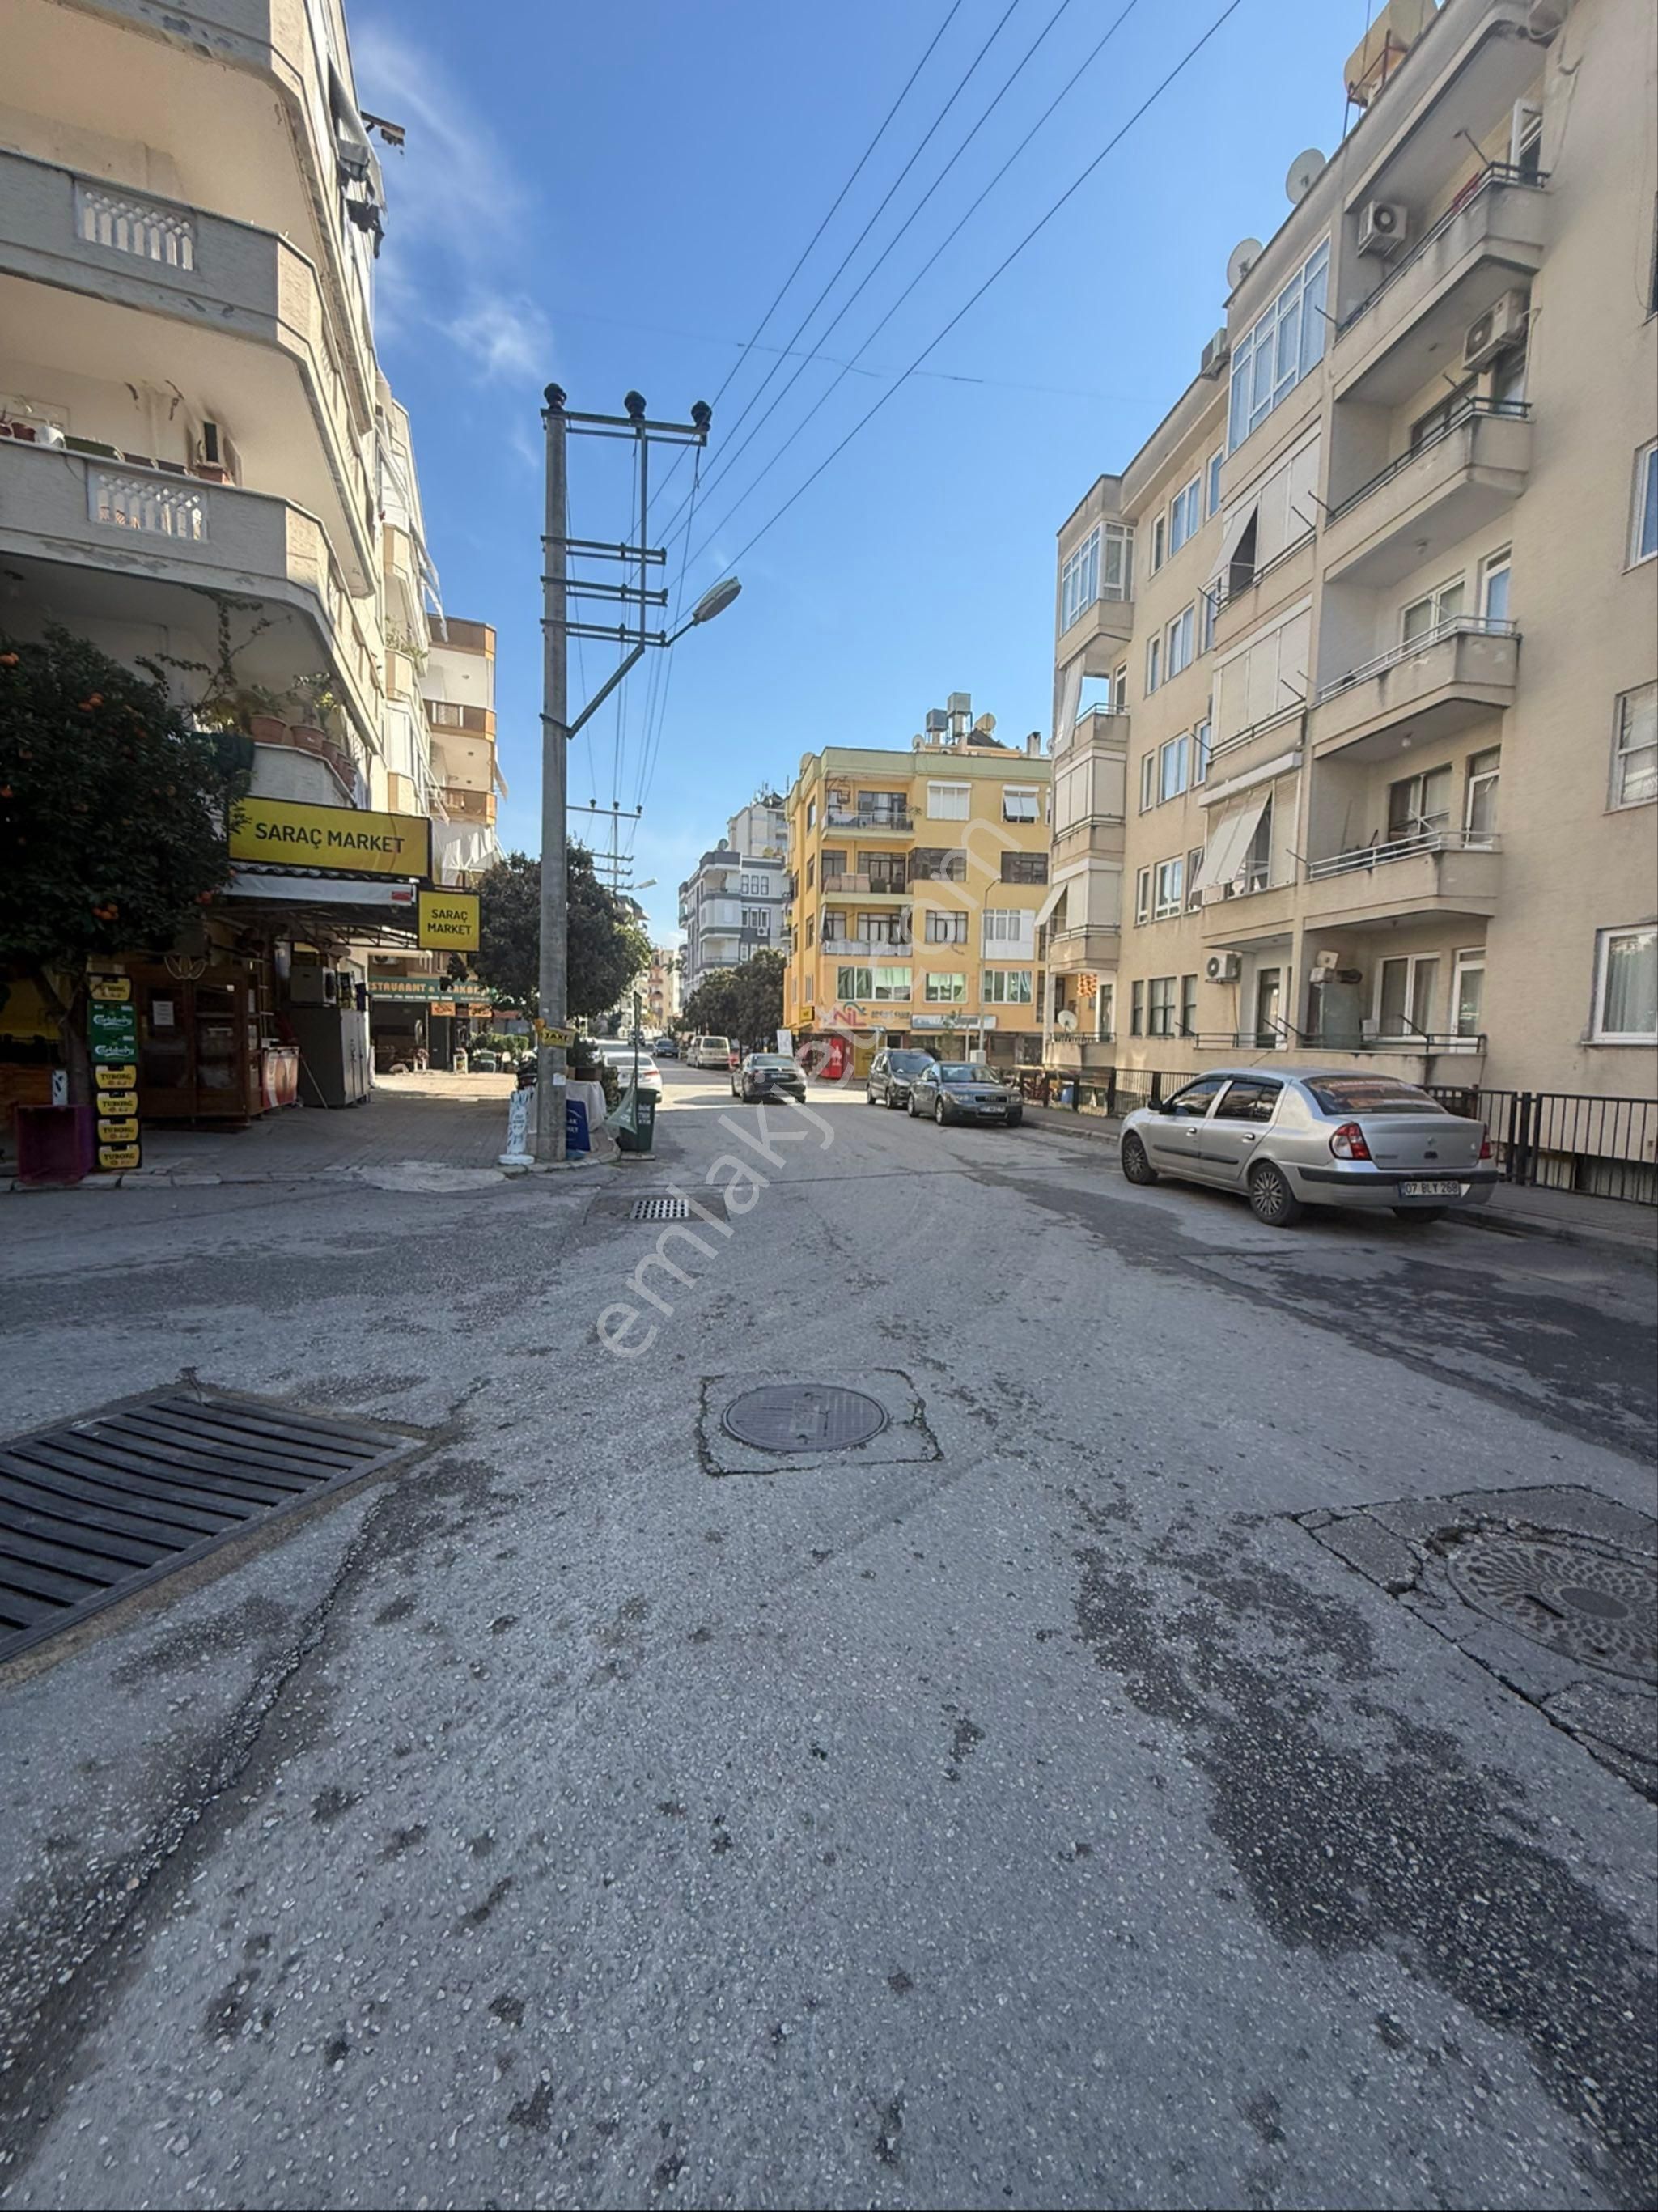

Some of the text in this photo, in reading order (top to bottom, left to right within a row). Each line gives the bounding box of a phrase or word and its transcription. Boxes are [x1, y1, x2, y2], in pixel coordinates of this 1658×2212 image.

[255, 822, 405, 854] SARAÇ MARKET
[431, 909, 468, 922] SARAÇ
[427, 923, 471, 936] MARKET
[1406, 1183, 1418, 1194] 07
